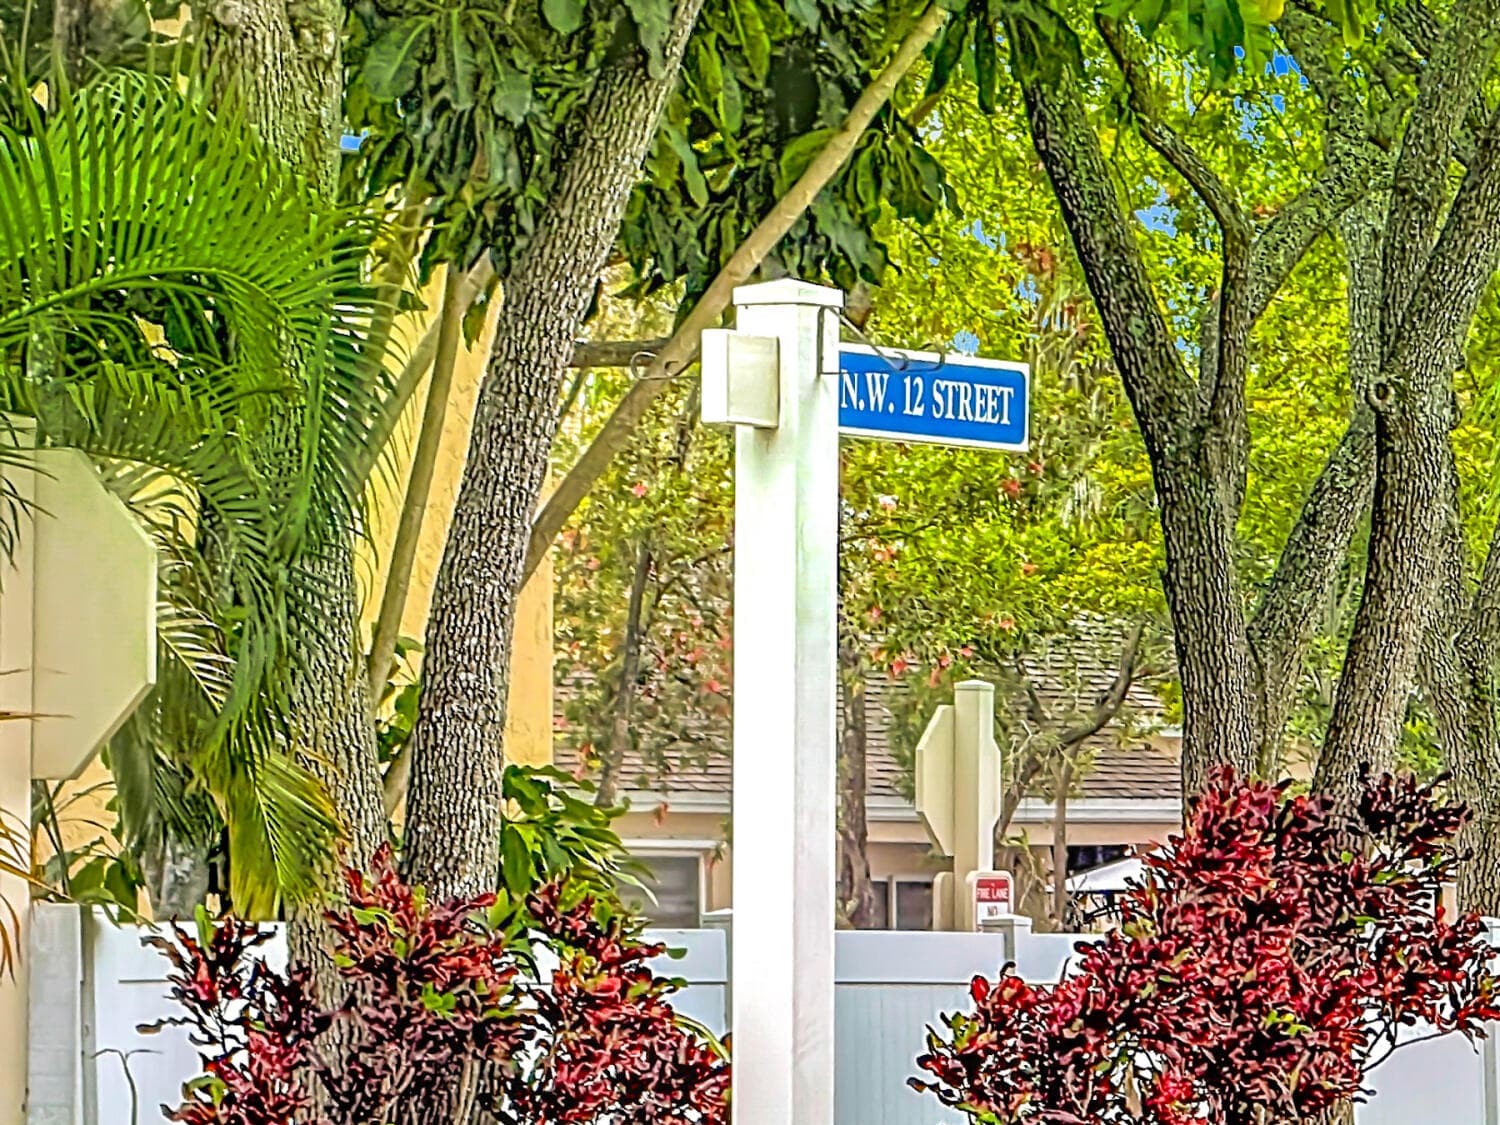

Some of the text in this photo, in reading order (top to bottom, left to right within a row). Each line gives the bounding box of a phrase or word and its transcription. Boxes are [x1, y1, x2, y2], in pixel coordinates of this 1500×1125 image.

[840, 368, 1015, 426] N.W. 12 STREET
